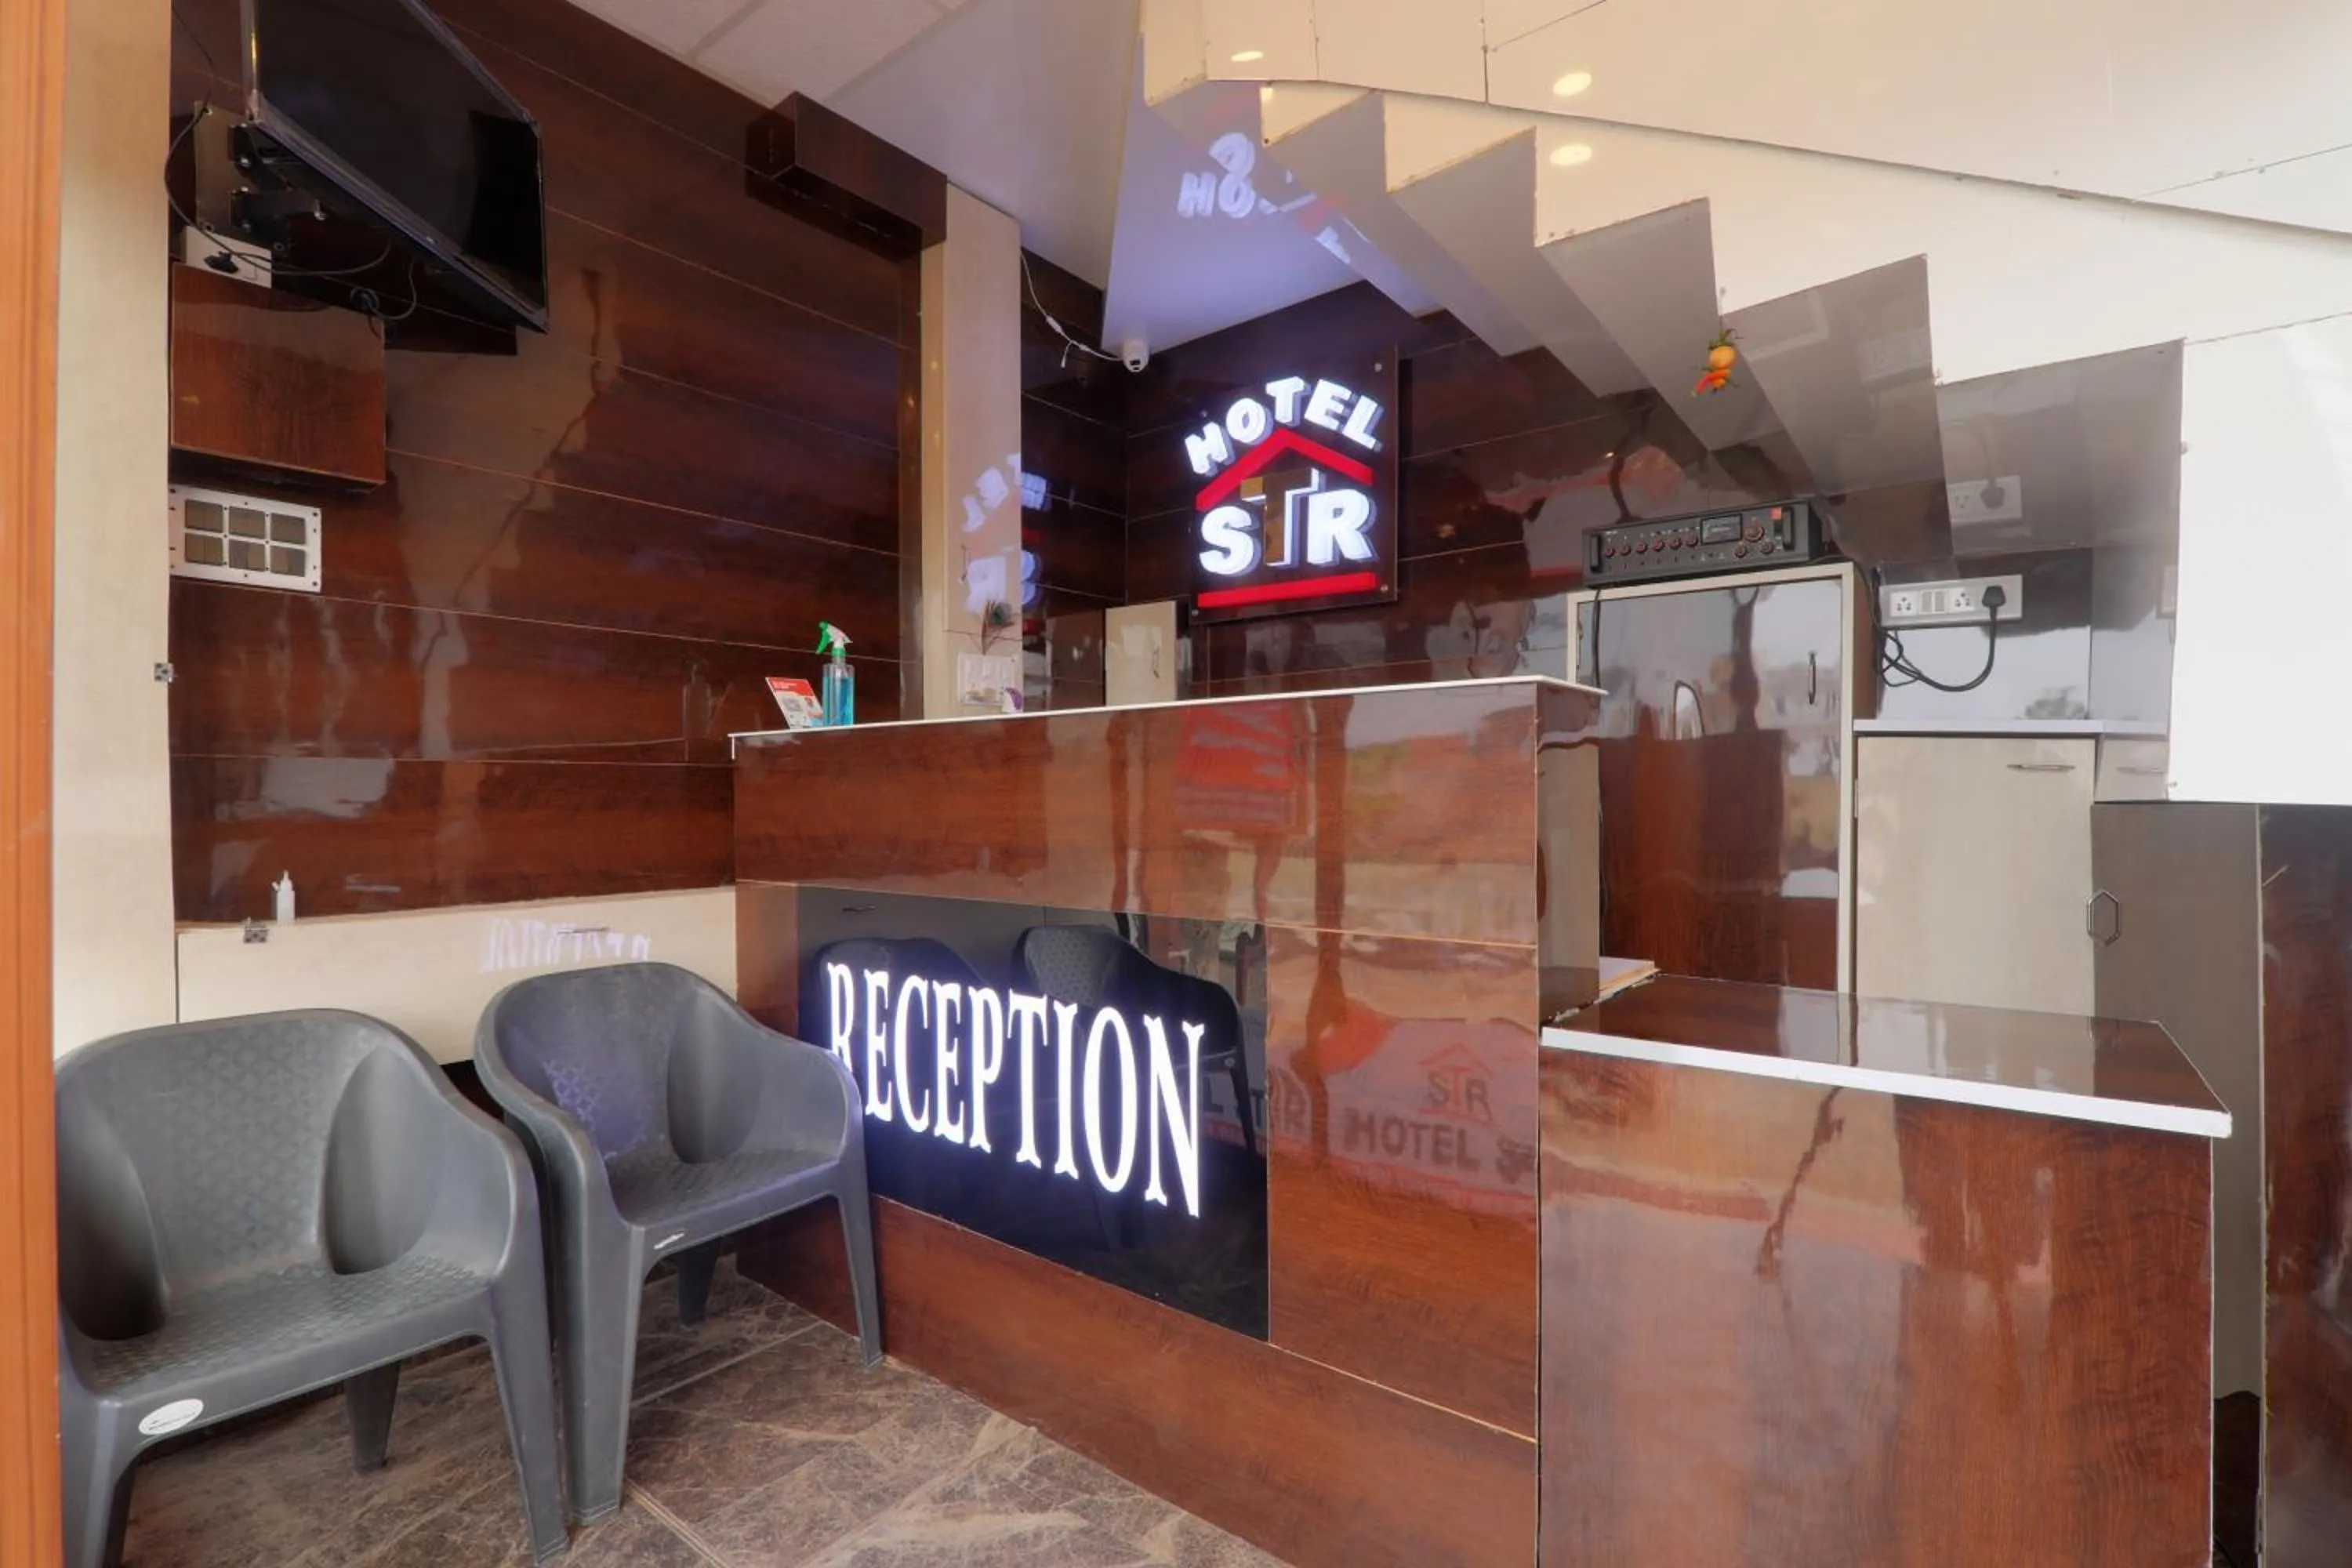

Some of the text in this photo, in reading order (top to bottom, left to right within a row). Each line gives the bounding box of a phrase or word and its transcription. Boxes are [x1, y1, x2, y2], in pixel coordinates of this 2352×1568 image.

[1185, 376, 1380, 474] HOTEL
[1200, 468, 1375, 575] STR
[827, 962, 1204, 1218] RECEPTION
[1342, 1106, 1480, 1171] HOTEL
